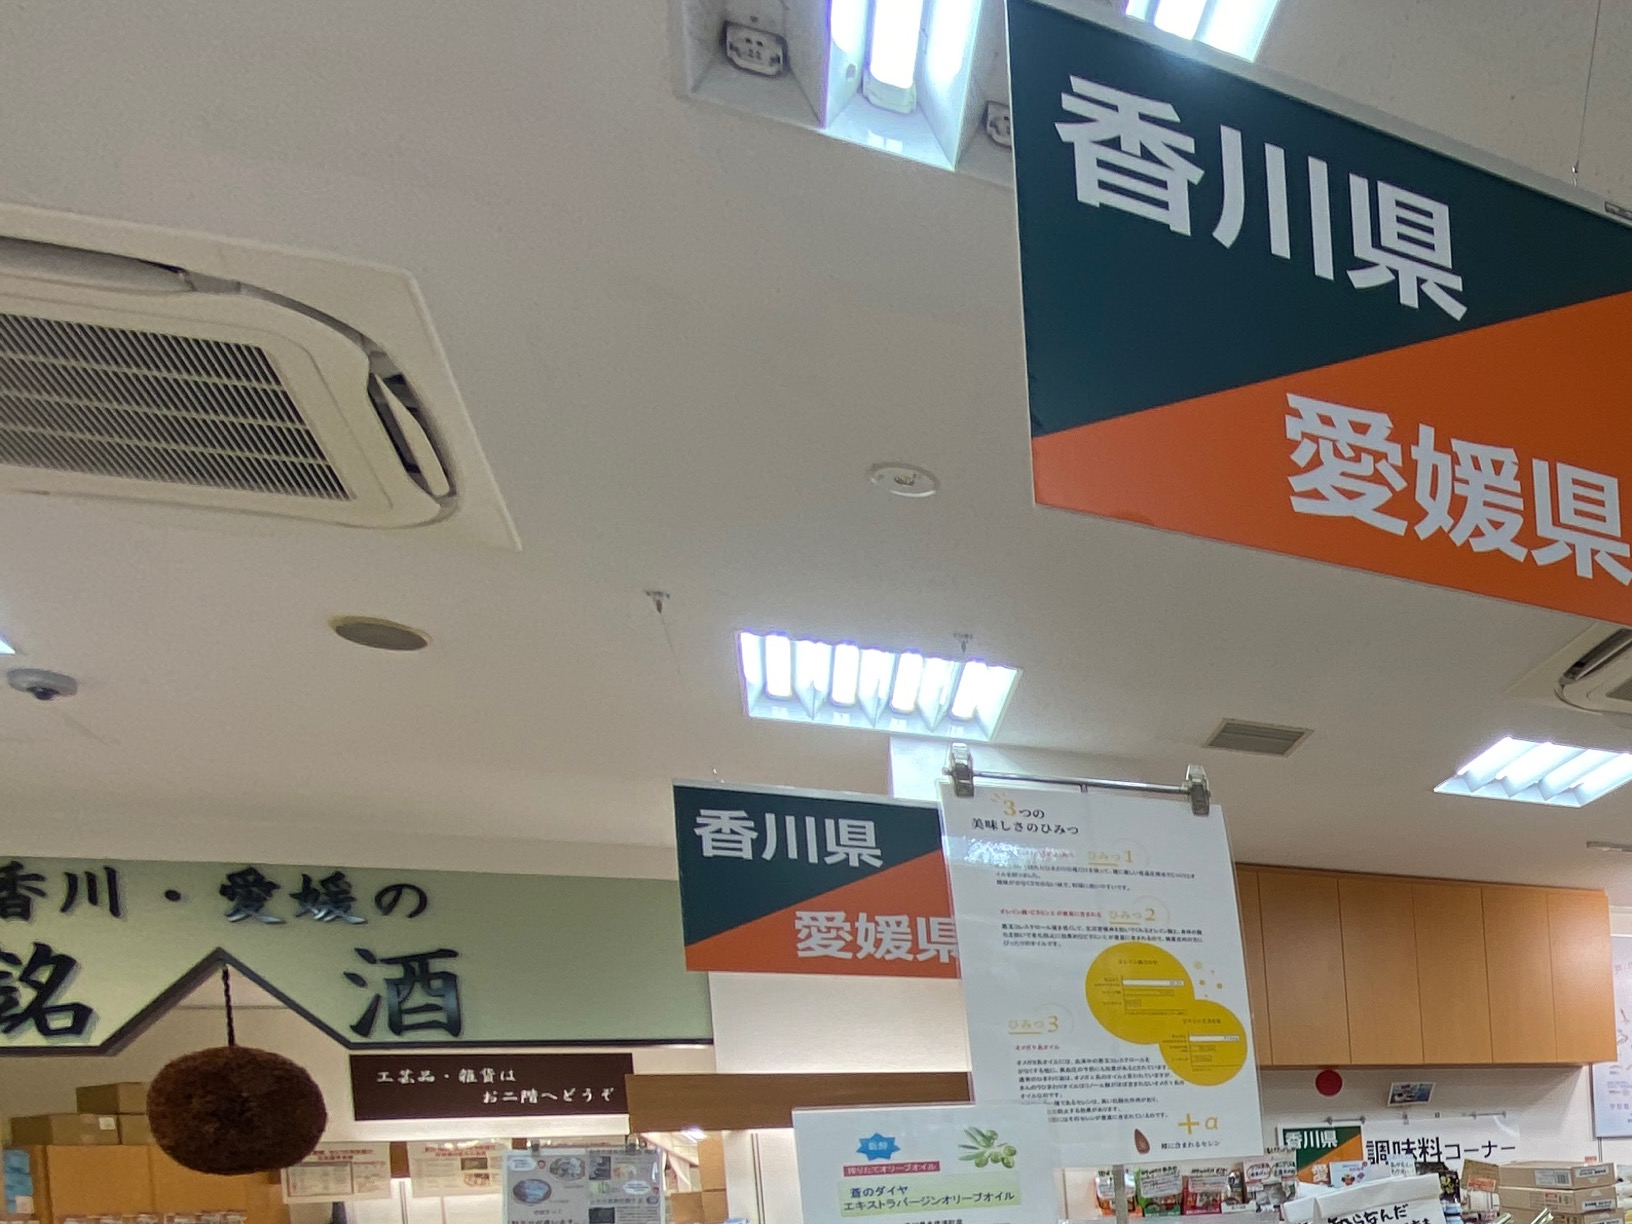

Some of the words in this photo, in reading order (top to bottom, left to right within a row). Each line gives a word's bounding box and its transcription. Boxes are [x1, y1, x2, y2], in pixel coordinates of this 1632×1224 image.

[1054, 74, 1467, 321] 香川県
[1003, 799, 1045, 819] 3つの
[972, 818, 1080, 835] 美味しさのひみつ
[694, 809, 883, 868] 香川県
[0, 861, 430, 925] 香川・愛媛の
[794, 912, 961, 962] 愛媛県
[0, 942, 96, 1039] 銘
[344, 947, 465, 1038] 酒
[377, 1068, 517, 1085] 工芸品・雑貨は
[483, 1087, 615, 1104] お二階へどうぞ
[1285, 1131, 1338, 1149] 香川県
[1367, 1137, 1516, 1166] 調味料コーナー
[844, 1192, 1015, 1212] エキストラバージンオリーブオイル
[850, 1186, 908, 1199] 蒼のダイヤ
